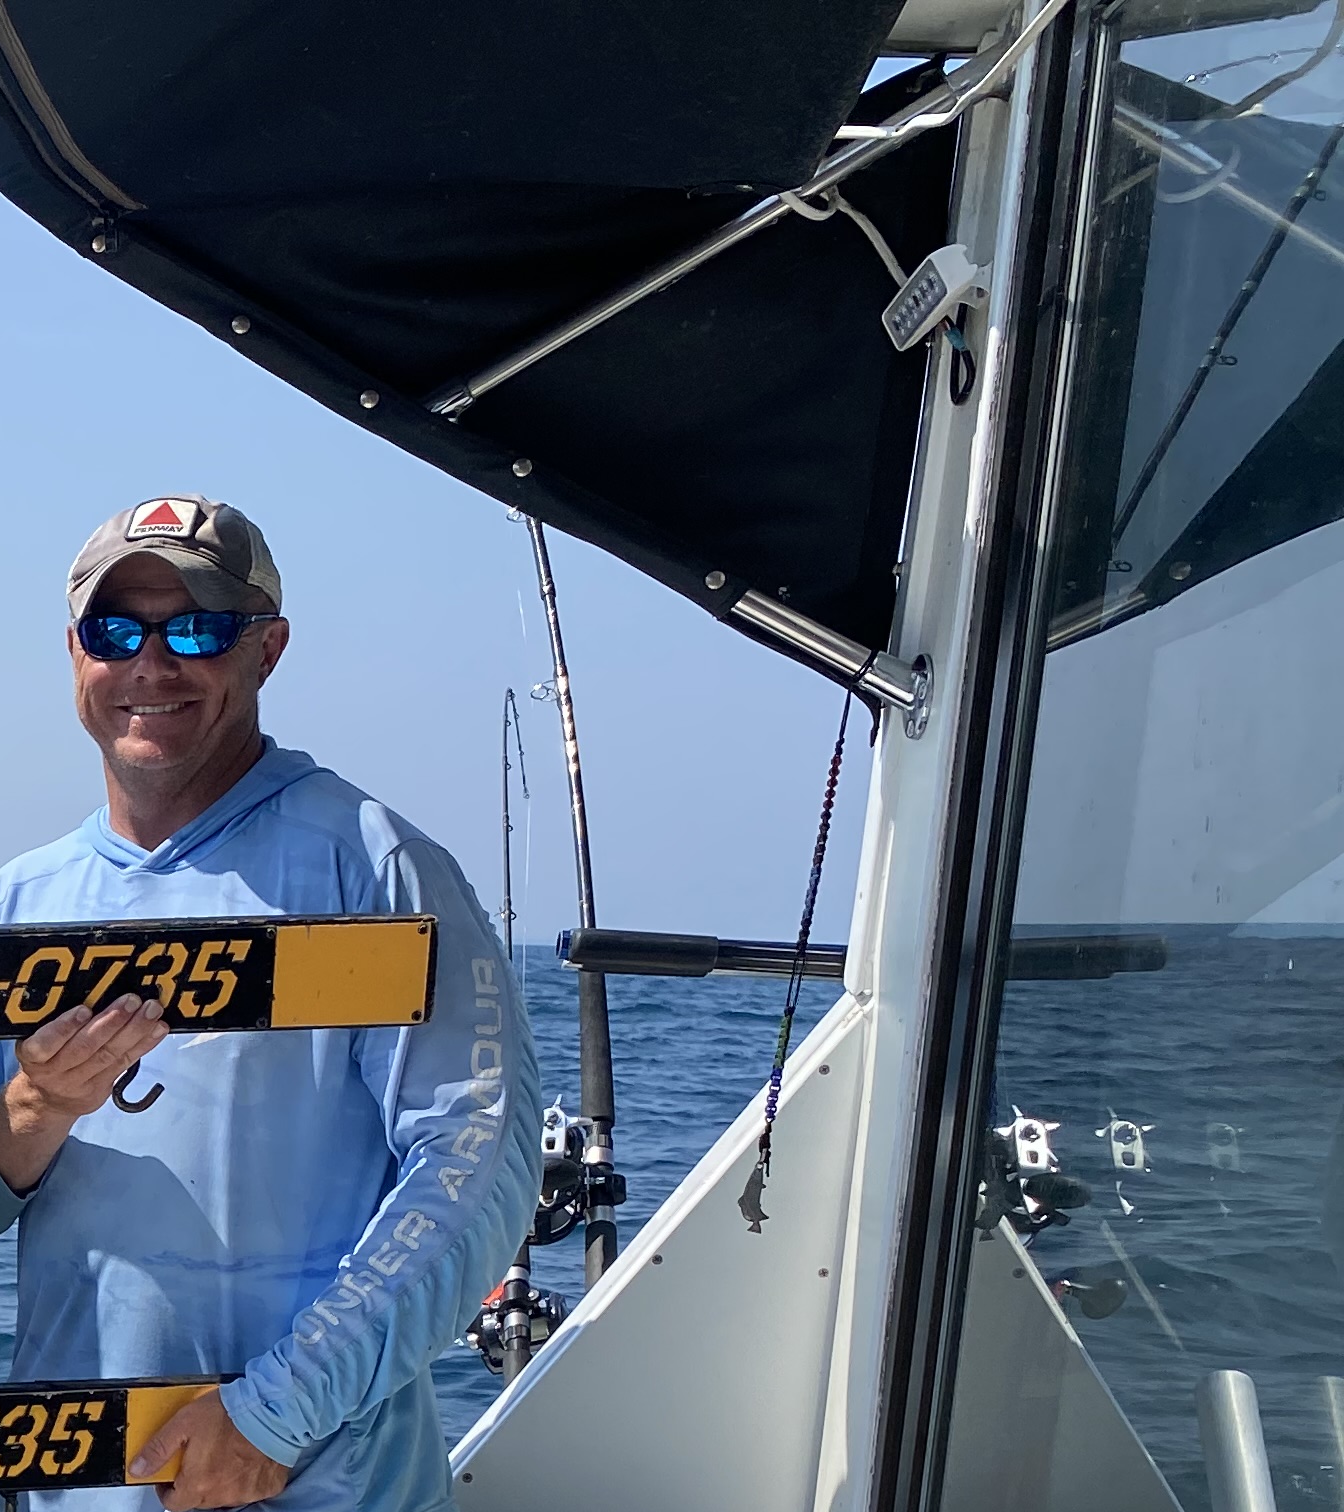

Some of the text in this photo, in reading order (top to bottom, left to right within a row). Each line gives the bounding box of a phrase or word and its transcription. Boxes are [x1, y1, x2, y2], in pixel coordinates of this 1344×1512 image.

[133, 525, 185, 534] FENWAY
[293, 956, 504, 1347] UNDER ARMOUR
